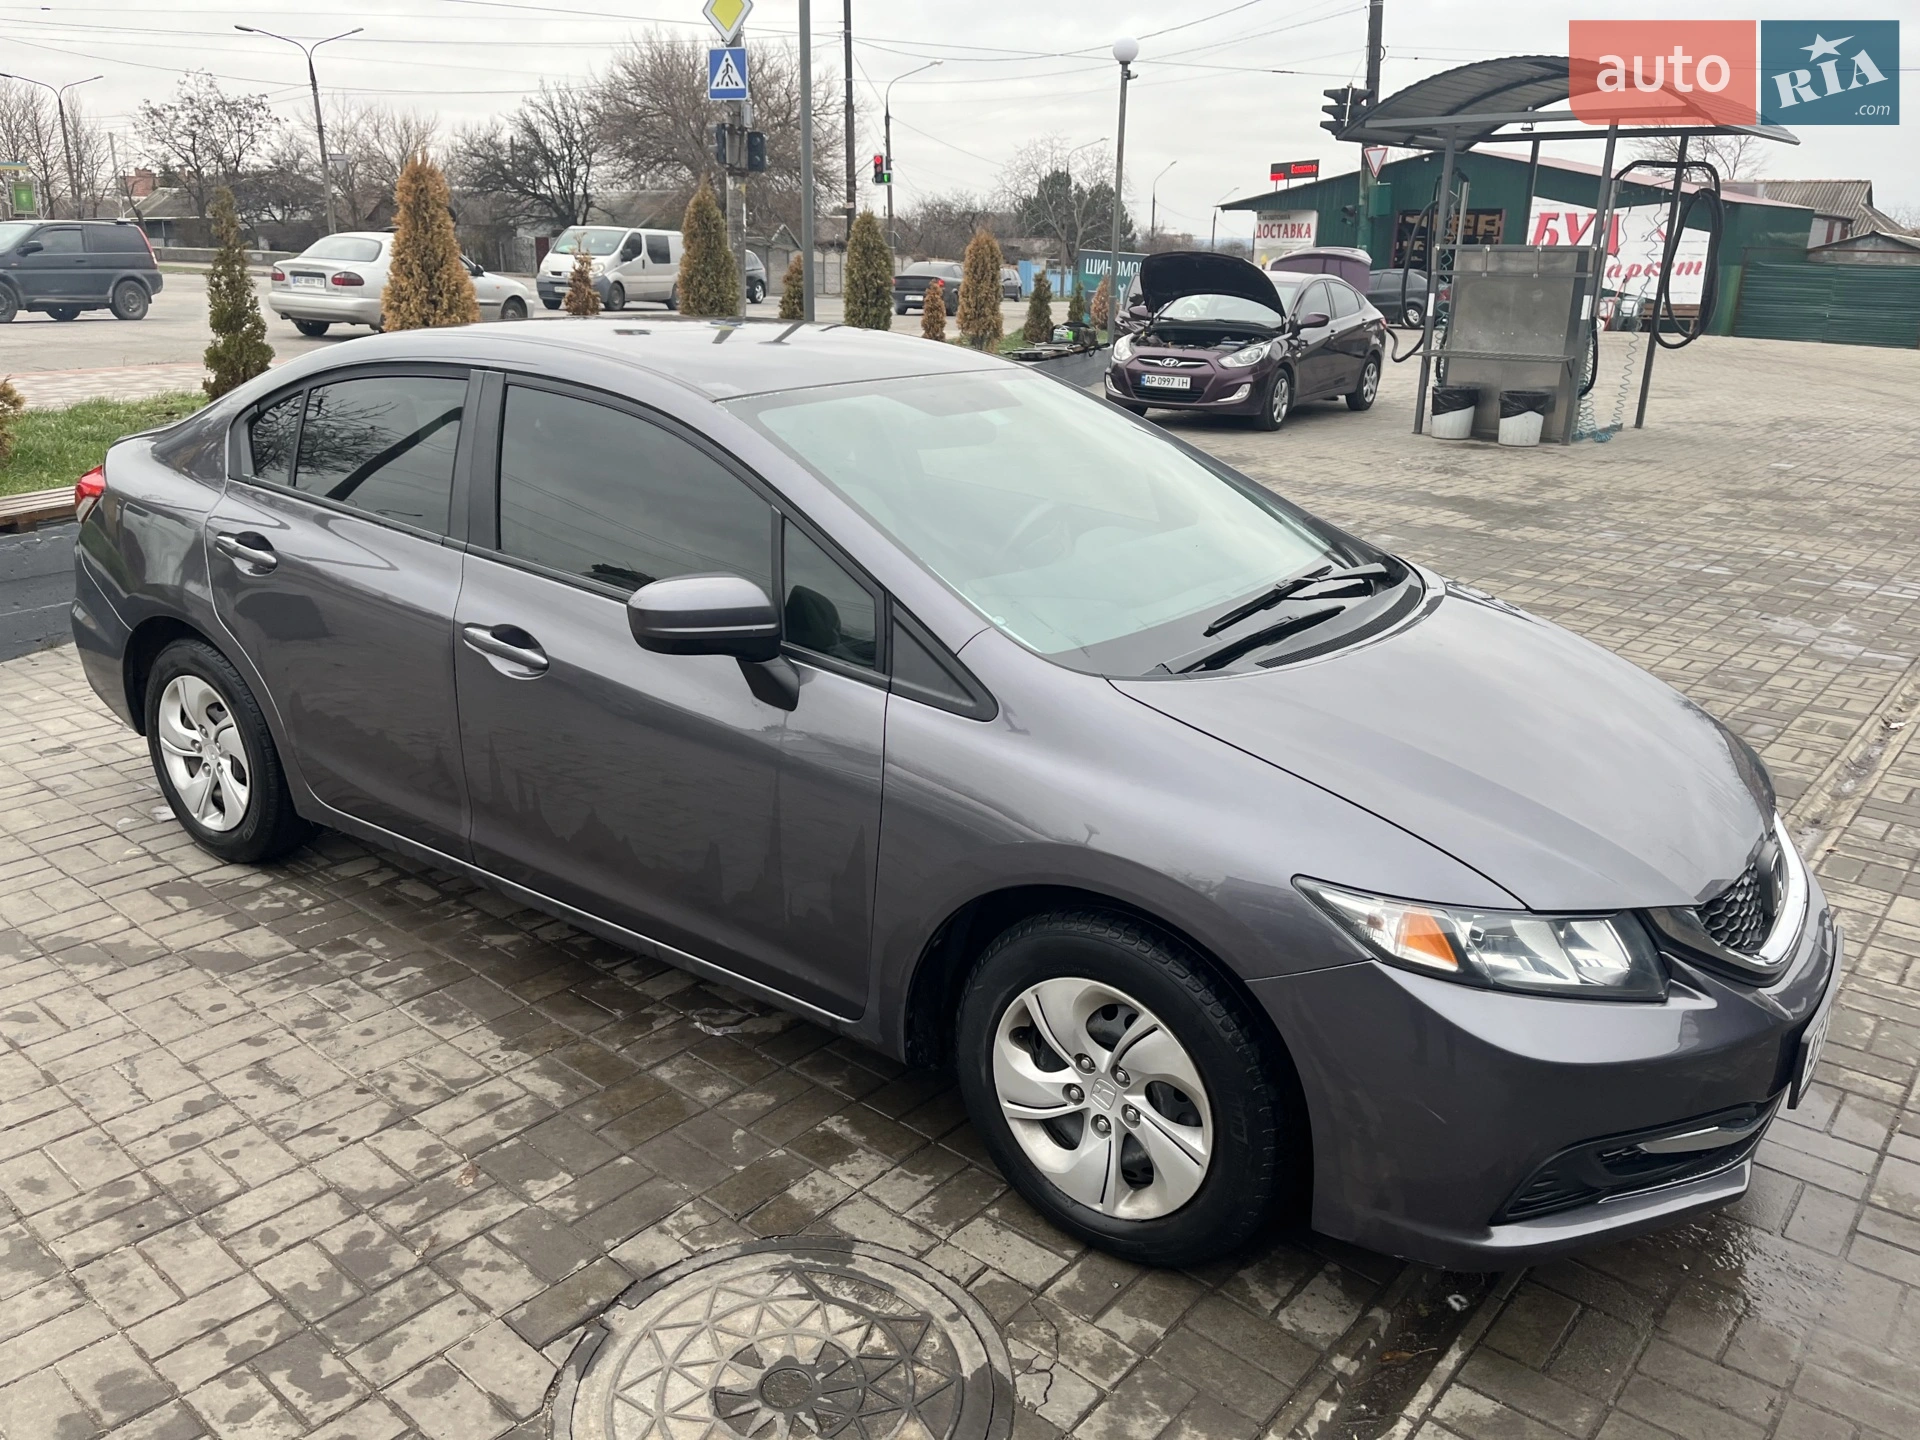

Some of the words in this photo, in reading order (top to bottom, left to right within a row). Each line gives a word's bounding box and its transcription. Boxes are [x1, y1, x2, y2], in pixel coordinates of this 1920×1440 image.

[1256, 223, 1312, 239] ДОСТАВКА
[1085, 258, 1142, 277] ШИНМО
[1145, 375, 1156, 384] AP
[1157, 377, 1175, 386] 0997
